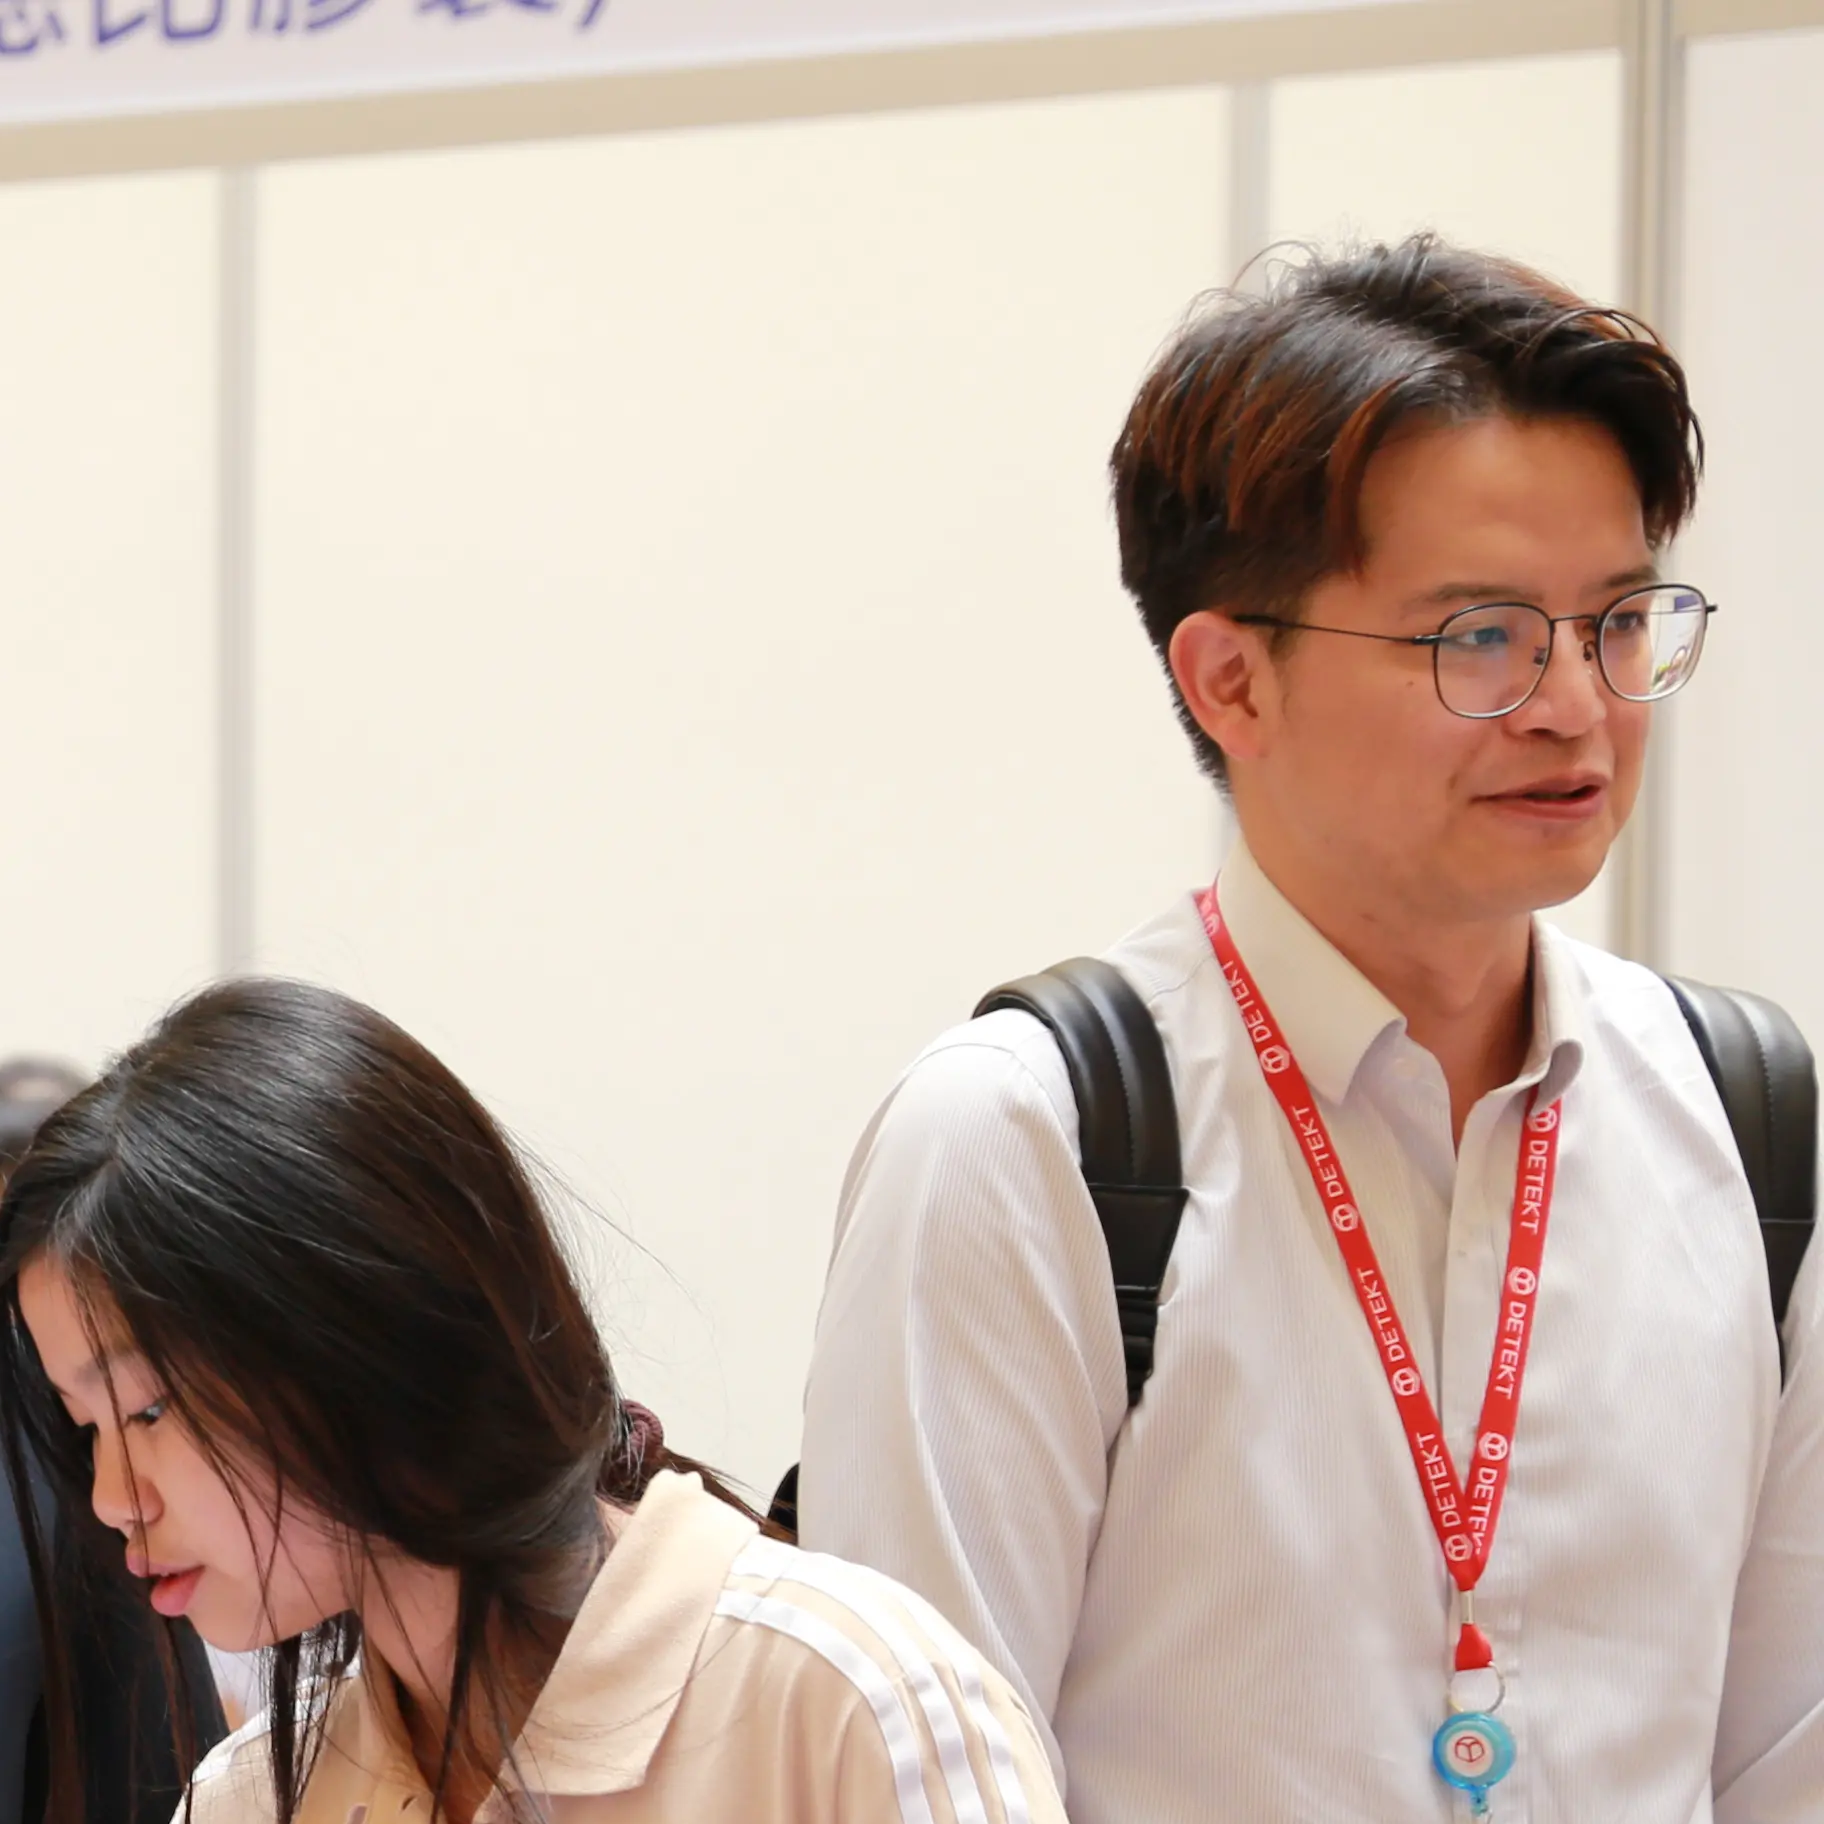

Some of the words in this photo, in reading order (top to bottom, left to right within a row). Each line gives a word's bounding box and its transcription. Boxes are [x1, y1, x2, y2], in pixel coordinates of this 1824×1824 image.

[1222, 960, 1272, 1043] DETEKT
[1292, 1104, 1344, 1198] DETEKT
[1520, 1140, 1549, 1235] DETEKT
[1357, 1267, 1405, 1362] DETEKT
[1495, 1301, 1527, 1400] DETEKT
[1417, 1432, 1461, 1528] DETEKT
